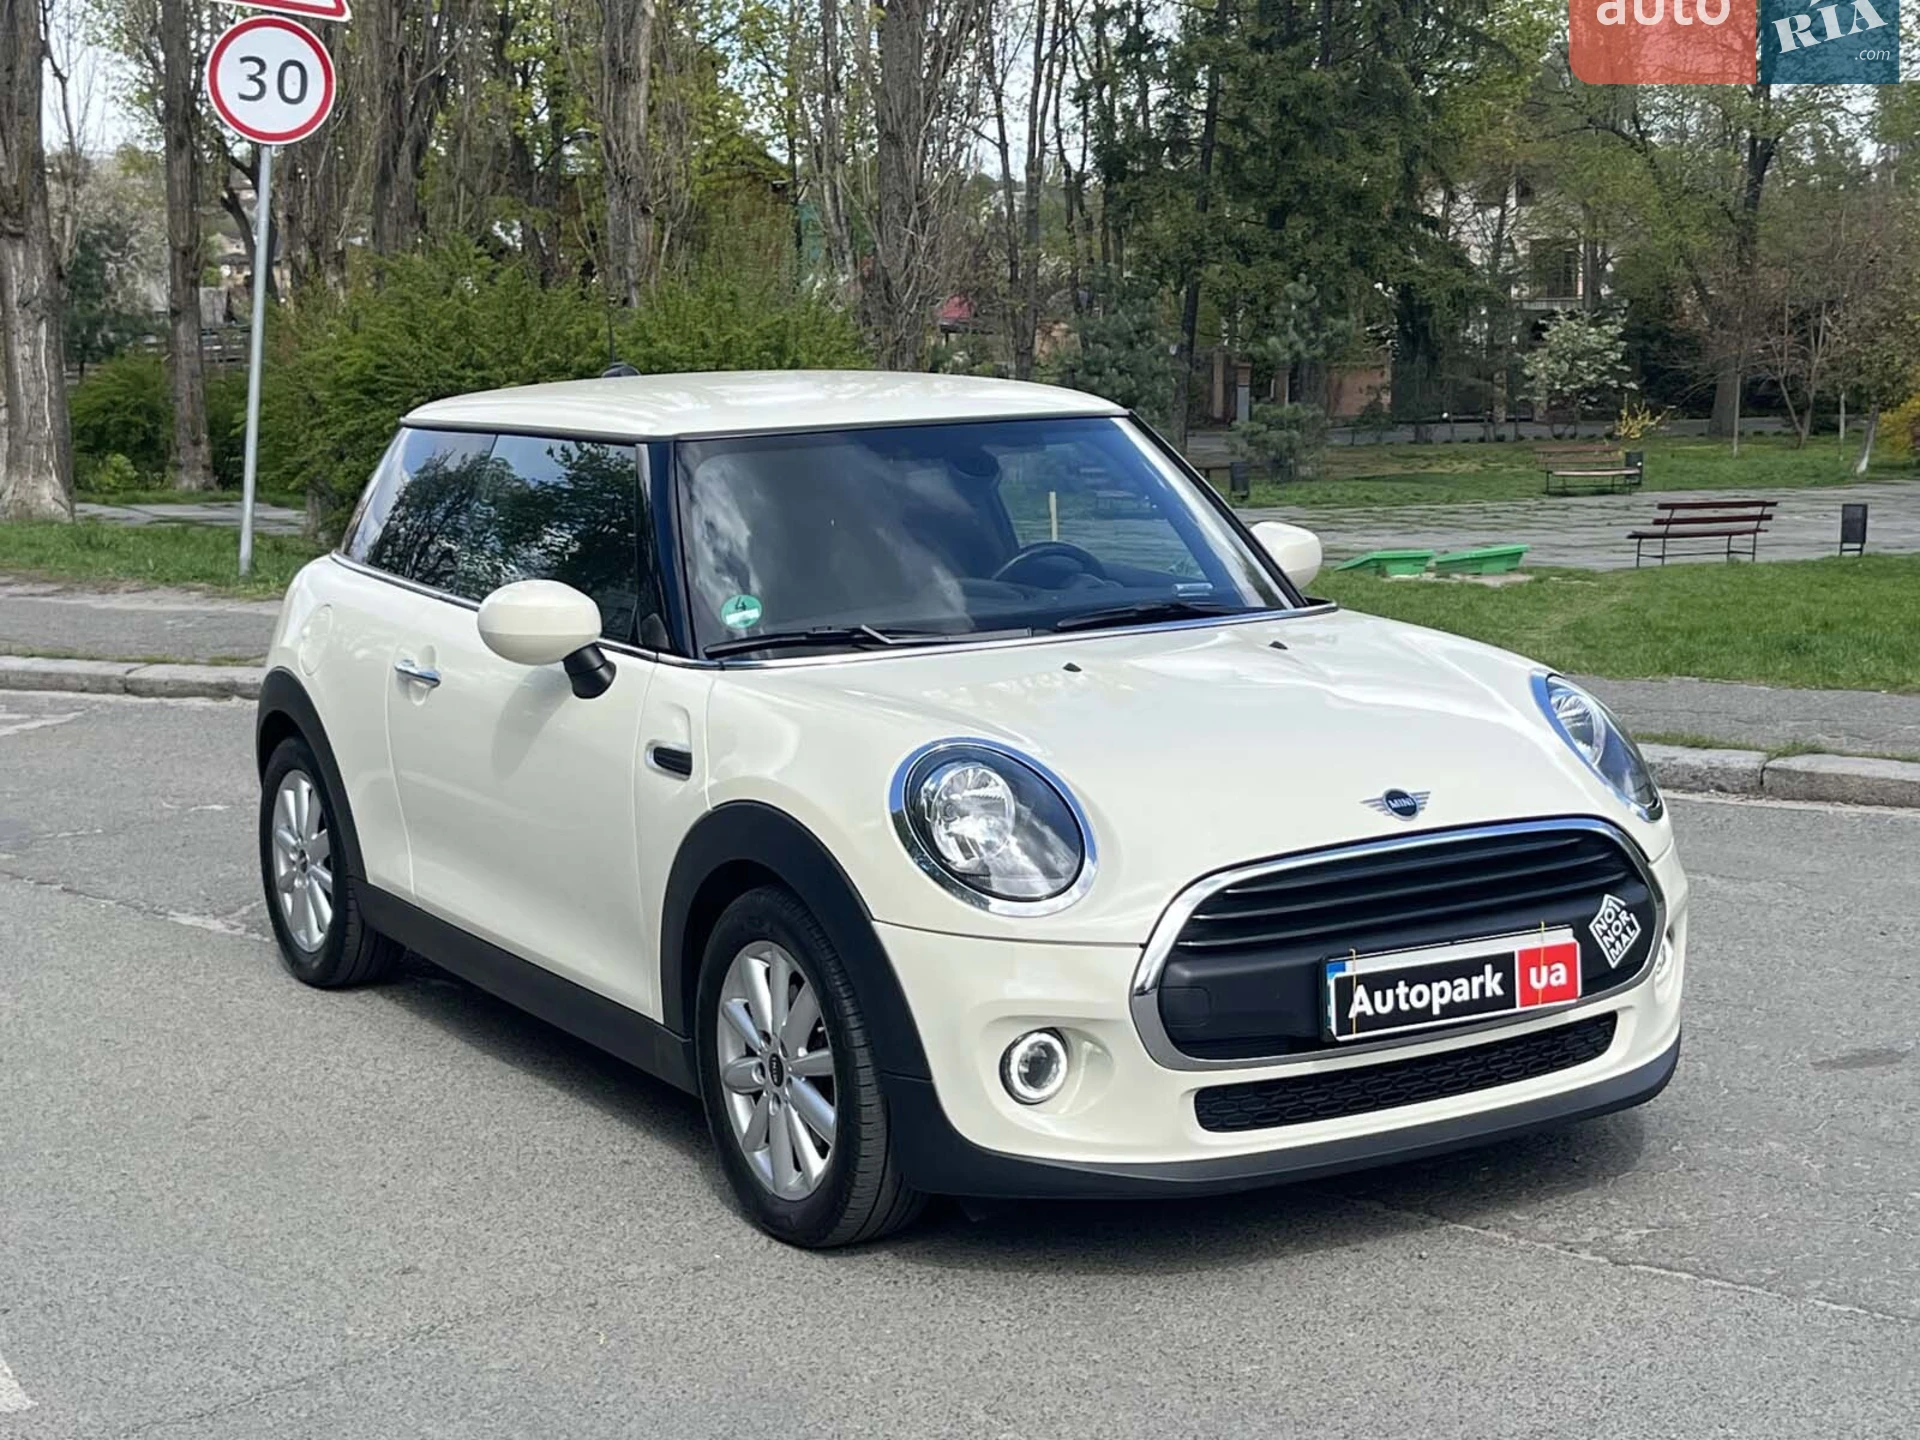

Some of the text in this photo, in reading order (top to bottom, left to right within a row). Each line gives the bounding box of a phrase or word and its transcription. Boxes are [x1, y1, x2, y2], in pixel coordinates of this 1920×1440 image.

[238, 56, 308, 105] 30
[1388, 797, 1415, 808] MINI
[1349, 962, 1567, 1018] Autopark ua
